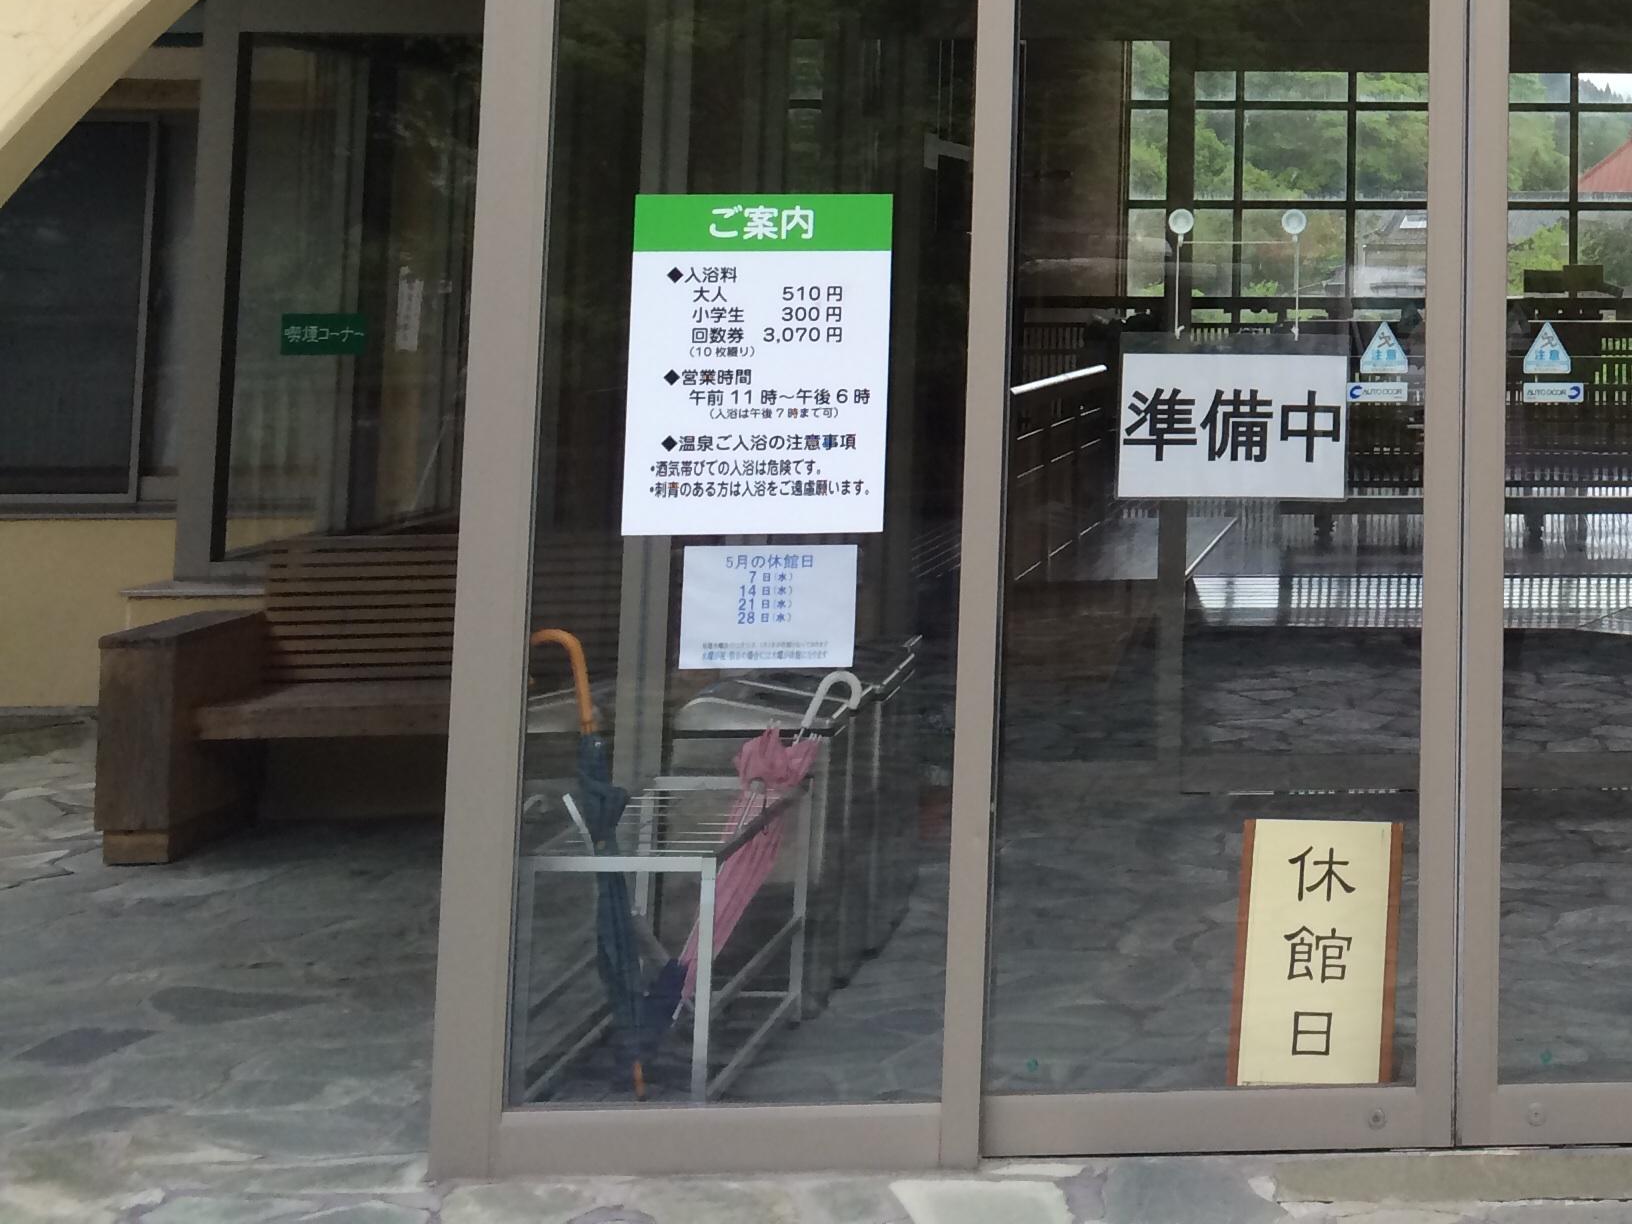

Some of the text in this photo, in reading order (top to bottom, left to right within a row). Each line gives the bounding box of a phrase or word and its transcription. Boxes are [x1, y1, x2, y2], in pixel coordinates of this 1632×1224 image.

[709, 204, 815, 240] ご案内
[684, 266, 738, 284] 入浴料
[693, 286, 728, 303] 大人
[692, 307, 745, 323] 小学生
[691, 327, 745, 344] 回数券
[681, 369, 752, 386] 営業時間
[1122, 388, 1342, 464] 準備中
[678, 433, 857, 452] 温泉ご入浴の注意事項
[726, 555, 814, 570] 5月の休館日
[1283, 845, 1356, 1056] 休館日
